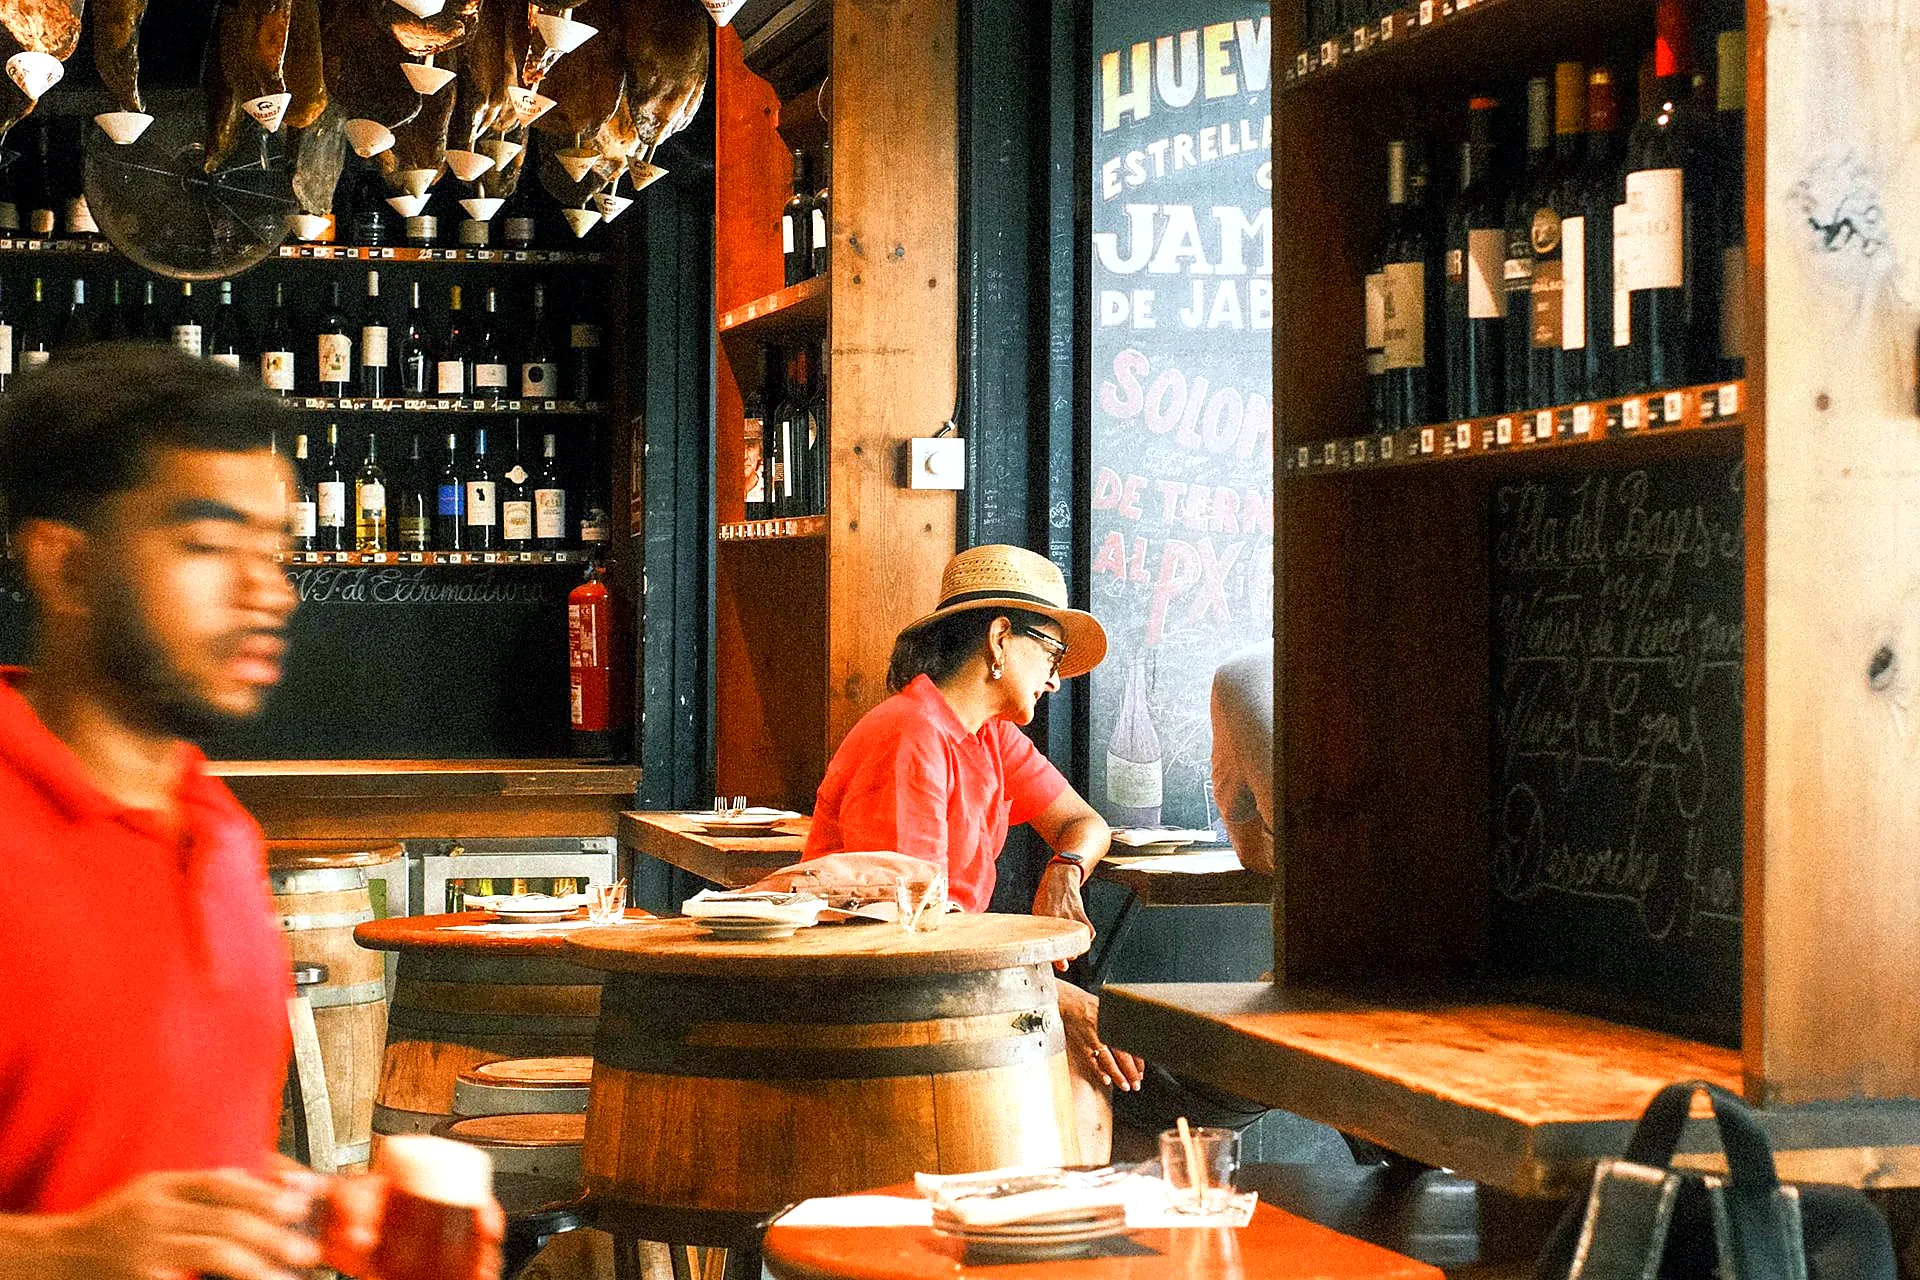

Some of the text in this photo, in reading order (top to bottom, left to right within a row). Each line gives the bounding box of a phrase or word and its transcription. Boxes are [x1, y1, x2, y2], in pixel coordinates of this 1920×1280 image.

[1099, 290, 1156, 328] DE
[1092, 466, 1148, 521] DE
[1093, 531, 1151, 584] AL
[1147, 537, 1248, 644] PX
